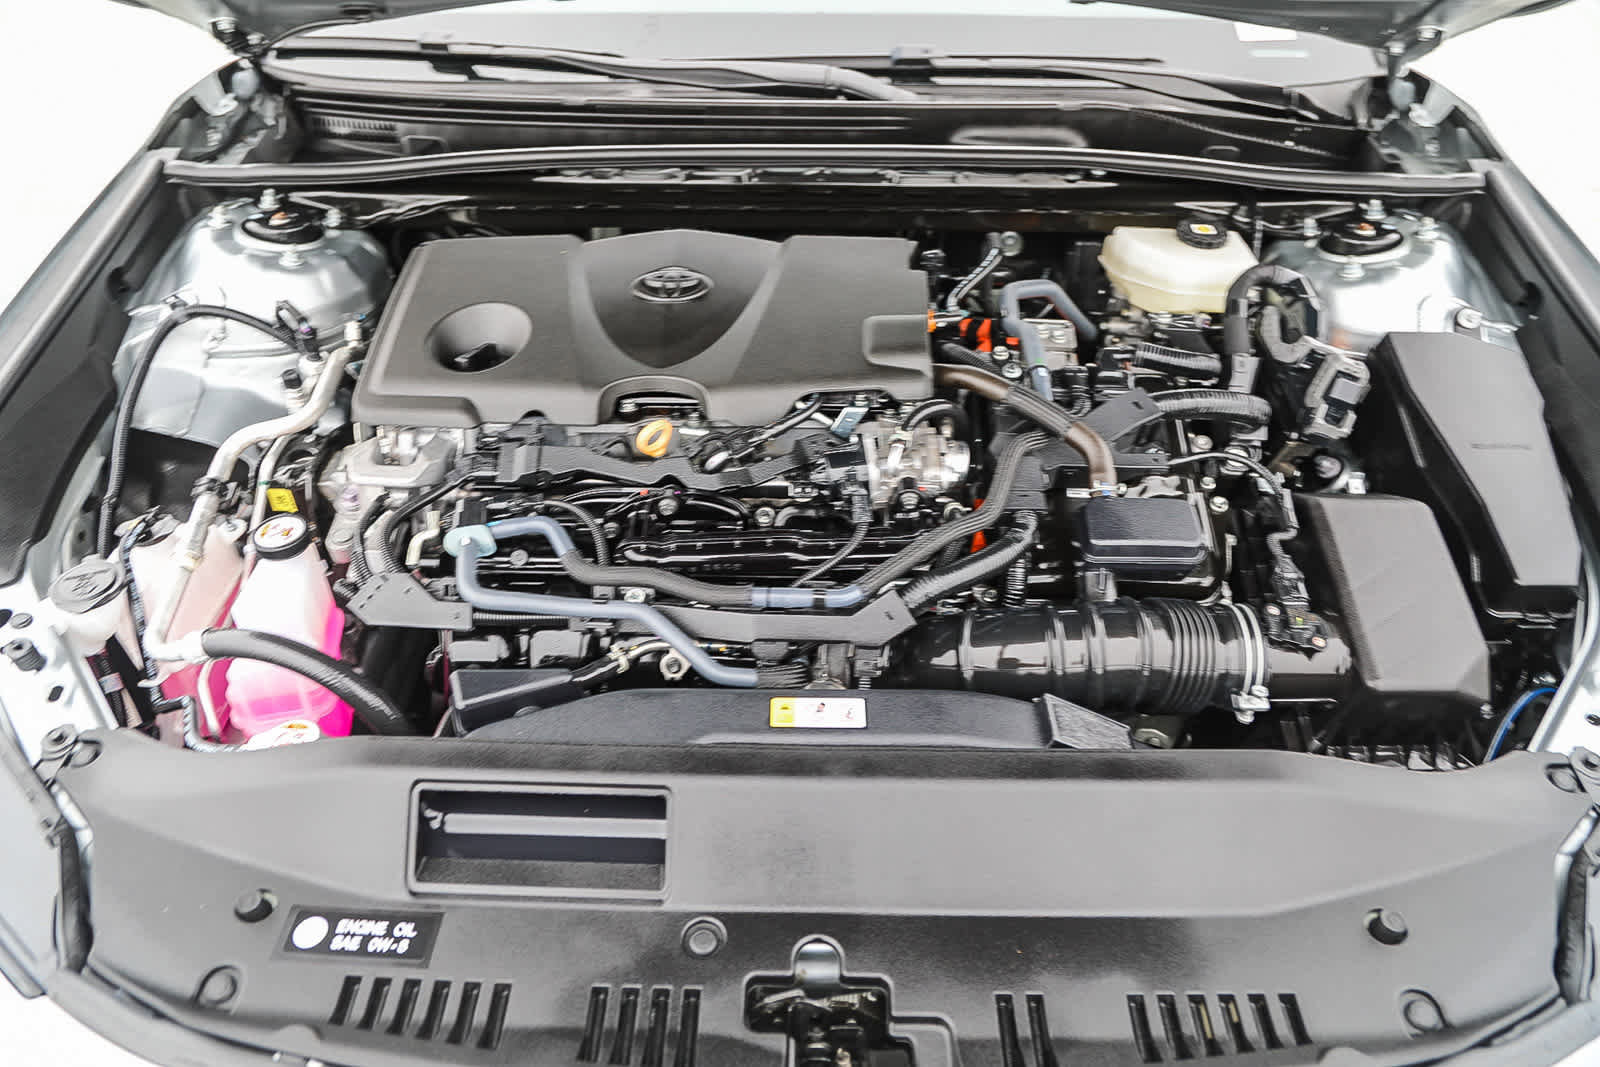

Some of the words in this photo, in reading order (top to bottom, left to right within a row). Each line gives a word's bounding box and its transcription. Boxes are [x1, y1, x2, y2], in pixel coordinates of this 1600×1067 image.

[335, 918, 390, 936] ENGINE
[393, 921, 418, 938] OIL
[329, 934, 363, 951] SAE
